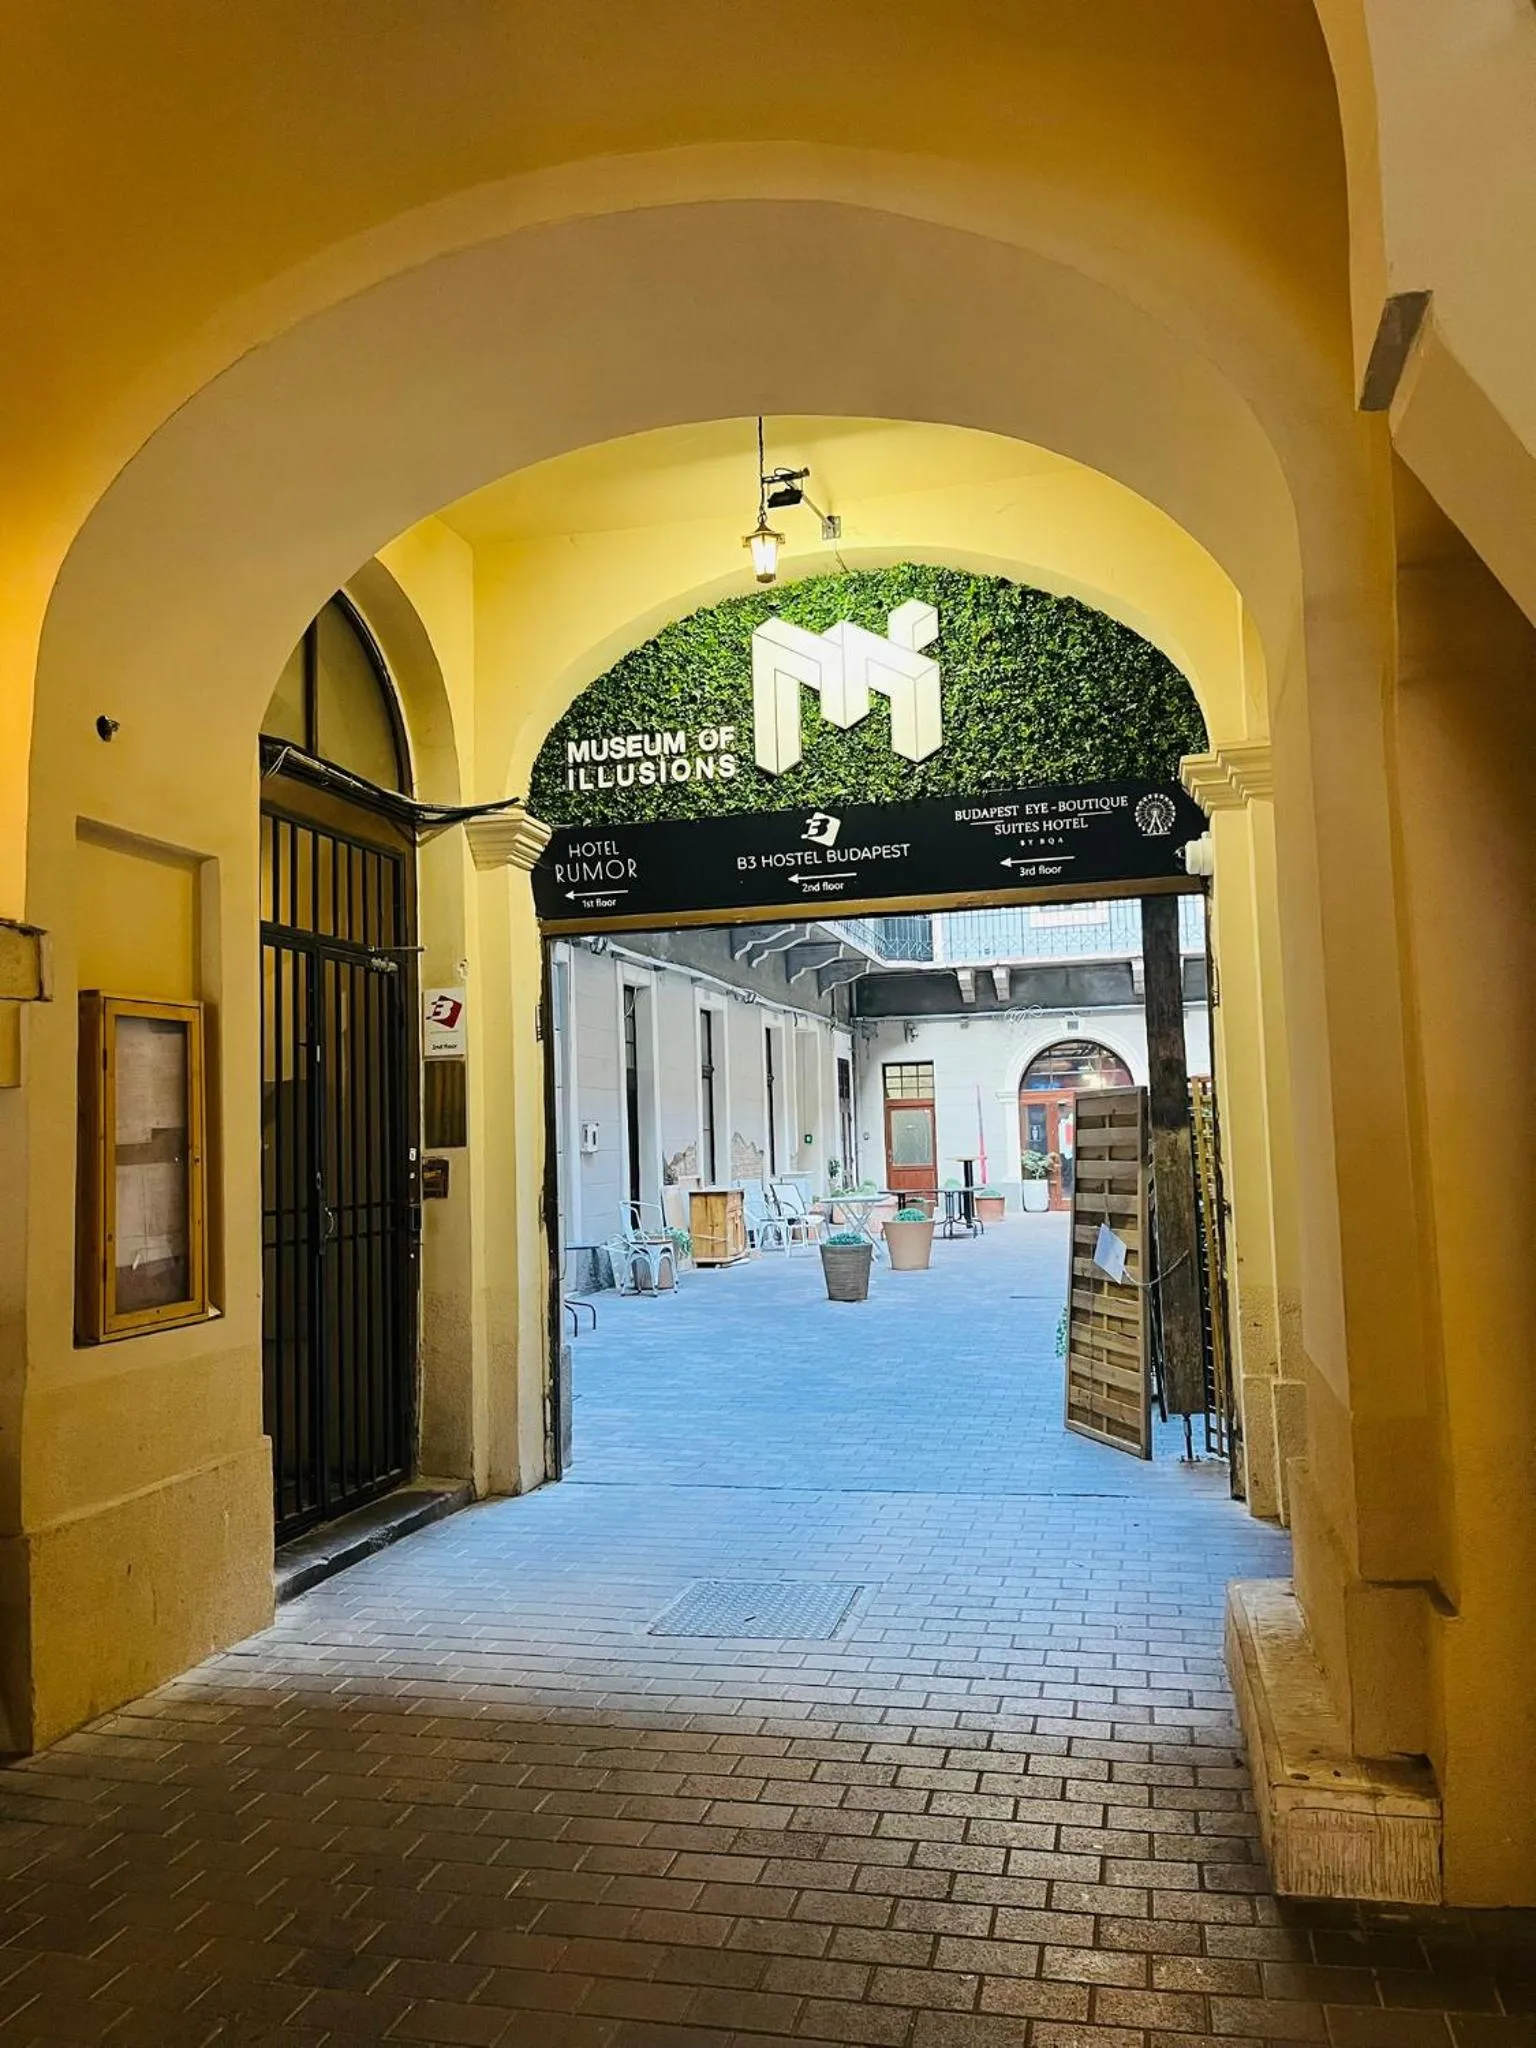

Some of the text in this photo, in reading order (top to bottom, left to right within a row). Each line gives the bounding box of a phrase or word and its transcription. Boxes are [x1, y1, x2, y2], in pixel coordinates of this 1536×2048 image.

[567, 726, 736, 764] MUSEUM OF
[567, 753, 737, 791] ILLUSIONS
[954, 805, 1020, 822] BUDAPEST
[994, 817, 1089, 836] SUITES HOTEL
[568, 841, 620, 859] HOTEL
[736, 843, 911, 871] B3 HOSTEL BUDAPEST
[555, 858, 638, 883] RUMOR
[1019, 864, 1063, 877] 3rd floor
[801, 881, 845, 893] 2nd floor
[582, 898, 617, 909] 1st floor
